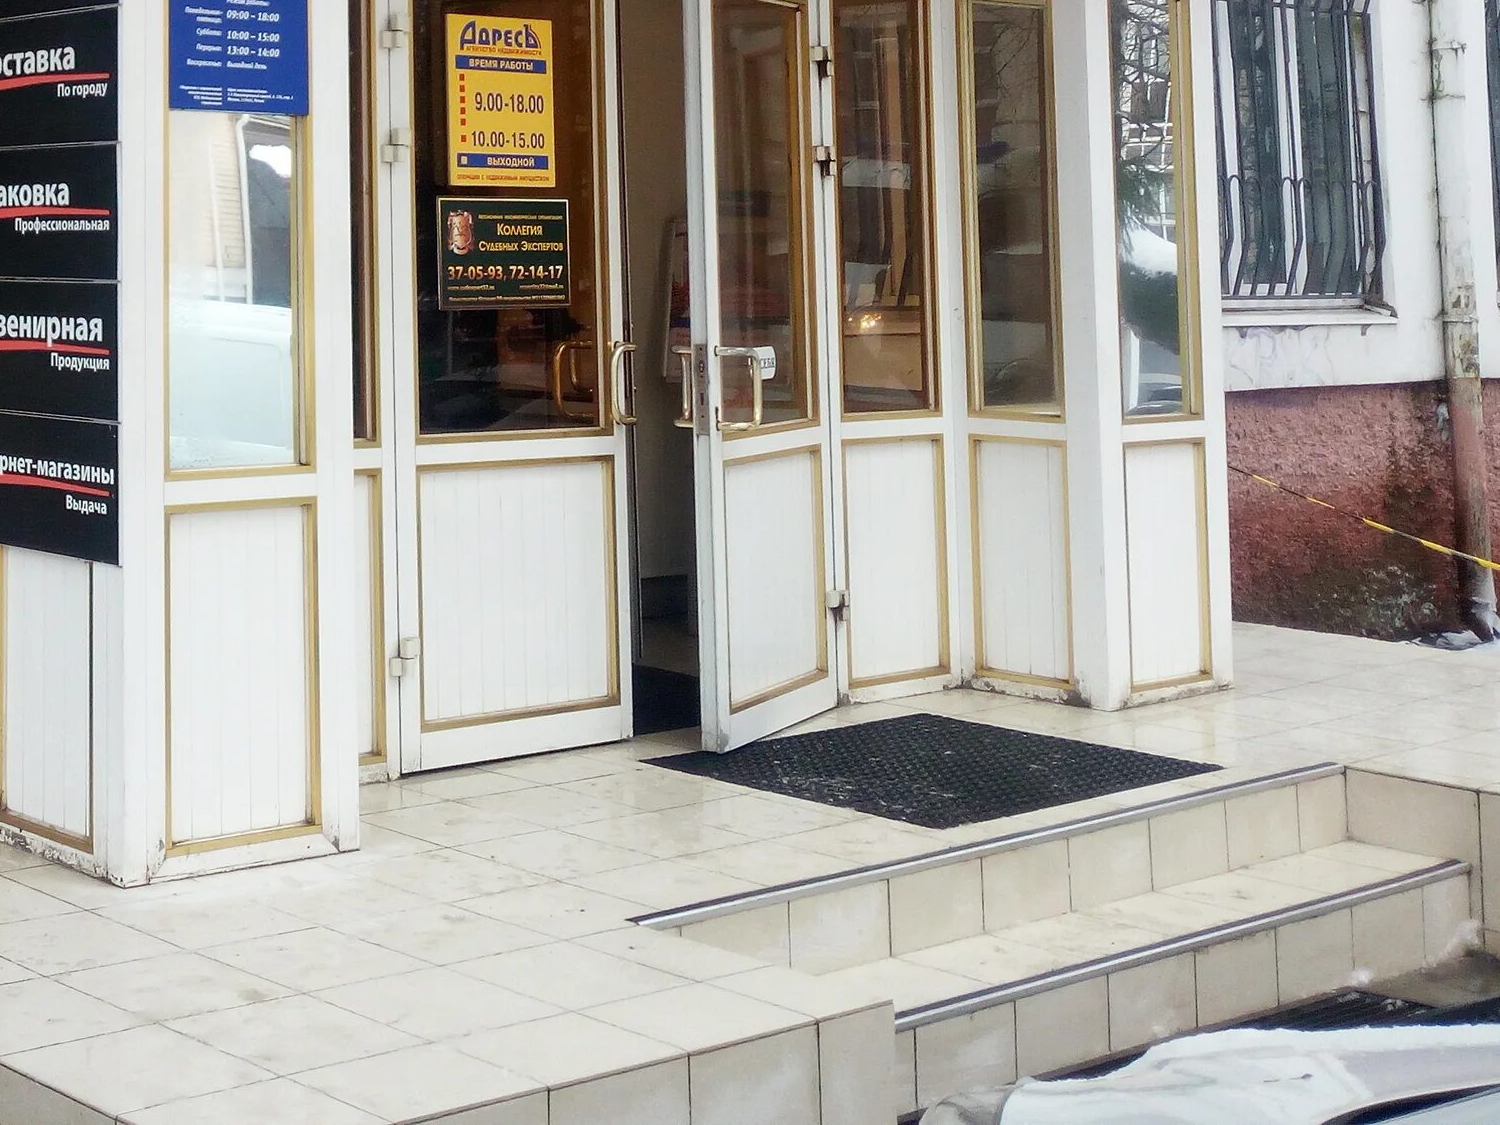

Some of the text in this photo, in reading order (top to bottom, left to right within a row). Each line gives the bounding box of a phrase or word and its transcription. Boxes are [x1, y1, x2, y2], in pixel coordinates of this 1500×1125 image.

[226, 10, 250, 20] 09:00
[258, 12, 280, 22] 18:00
[227, 30, 250, 40] 10:00
[258, 32, 280, 42] 15:00
[227, 46, 250, 55] 13:00
[258, 48, 280, 57] 14:00
[468, 58, 534, 71] ВРЕМЯ РАБОТЫ
[57, 82, 108, 98] По городу
[474, 91, 544, 114] 9.00-18.00
[471, 130, 545, 149] 10.00-15.00
[487, 156, 535, 168] ВЫХОДНОЙ
[14, 217, 110, 234] Профессиональная
[448, 265, 564, 281] 37-05-93, 72-14-17
[50, 352, 110, 371] Продукция
[65, 494, 108, 515] Выдача
